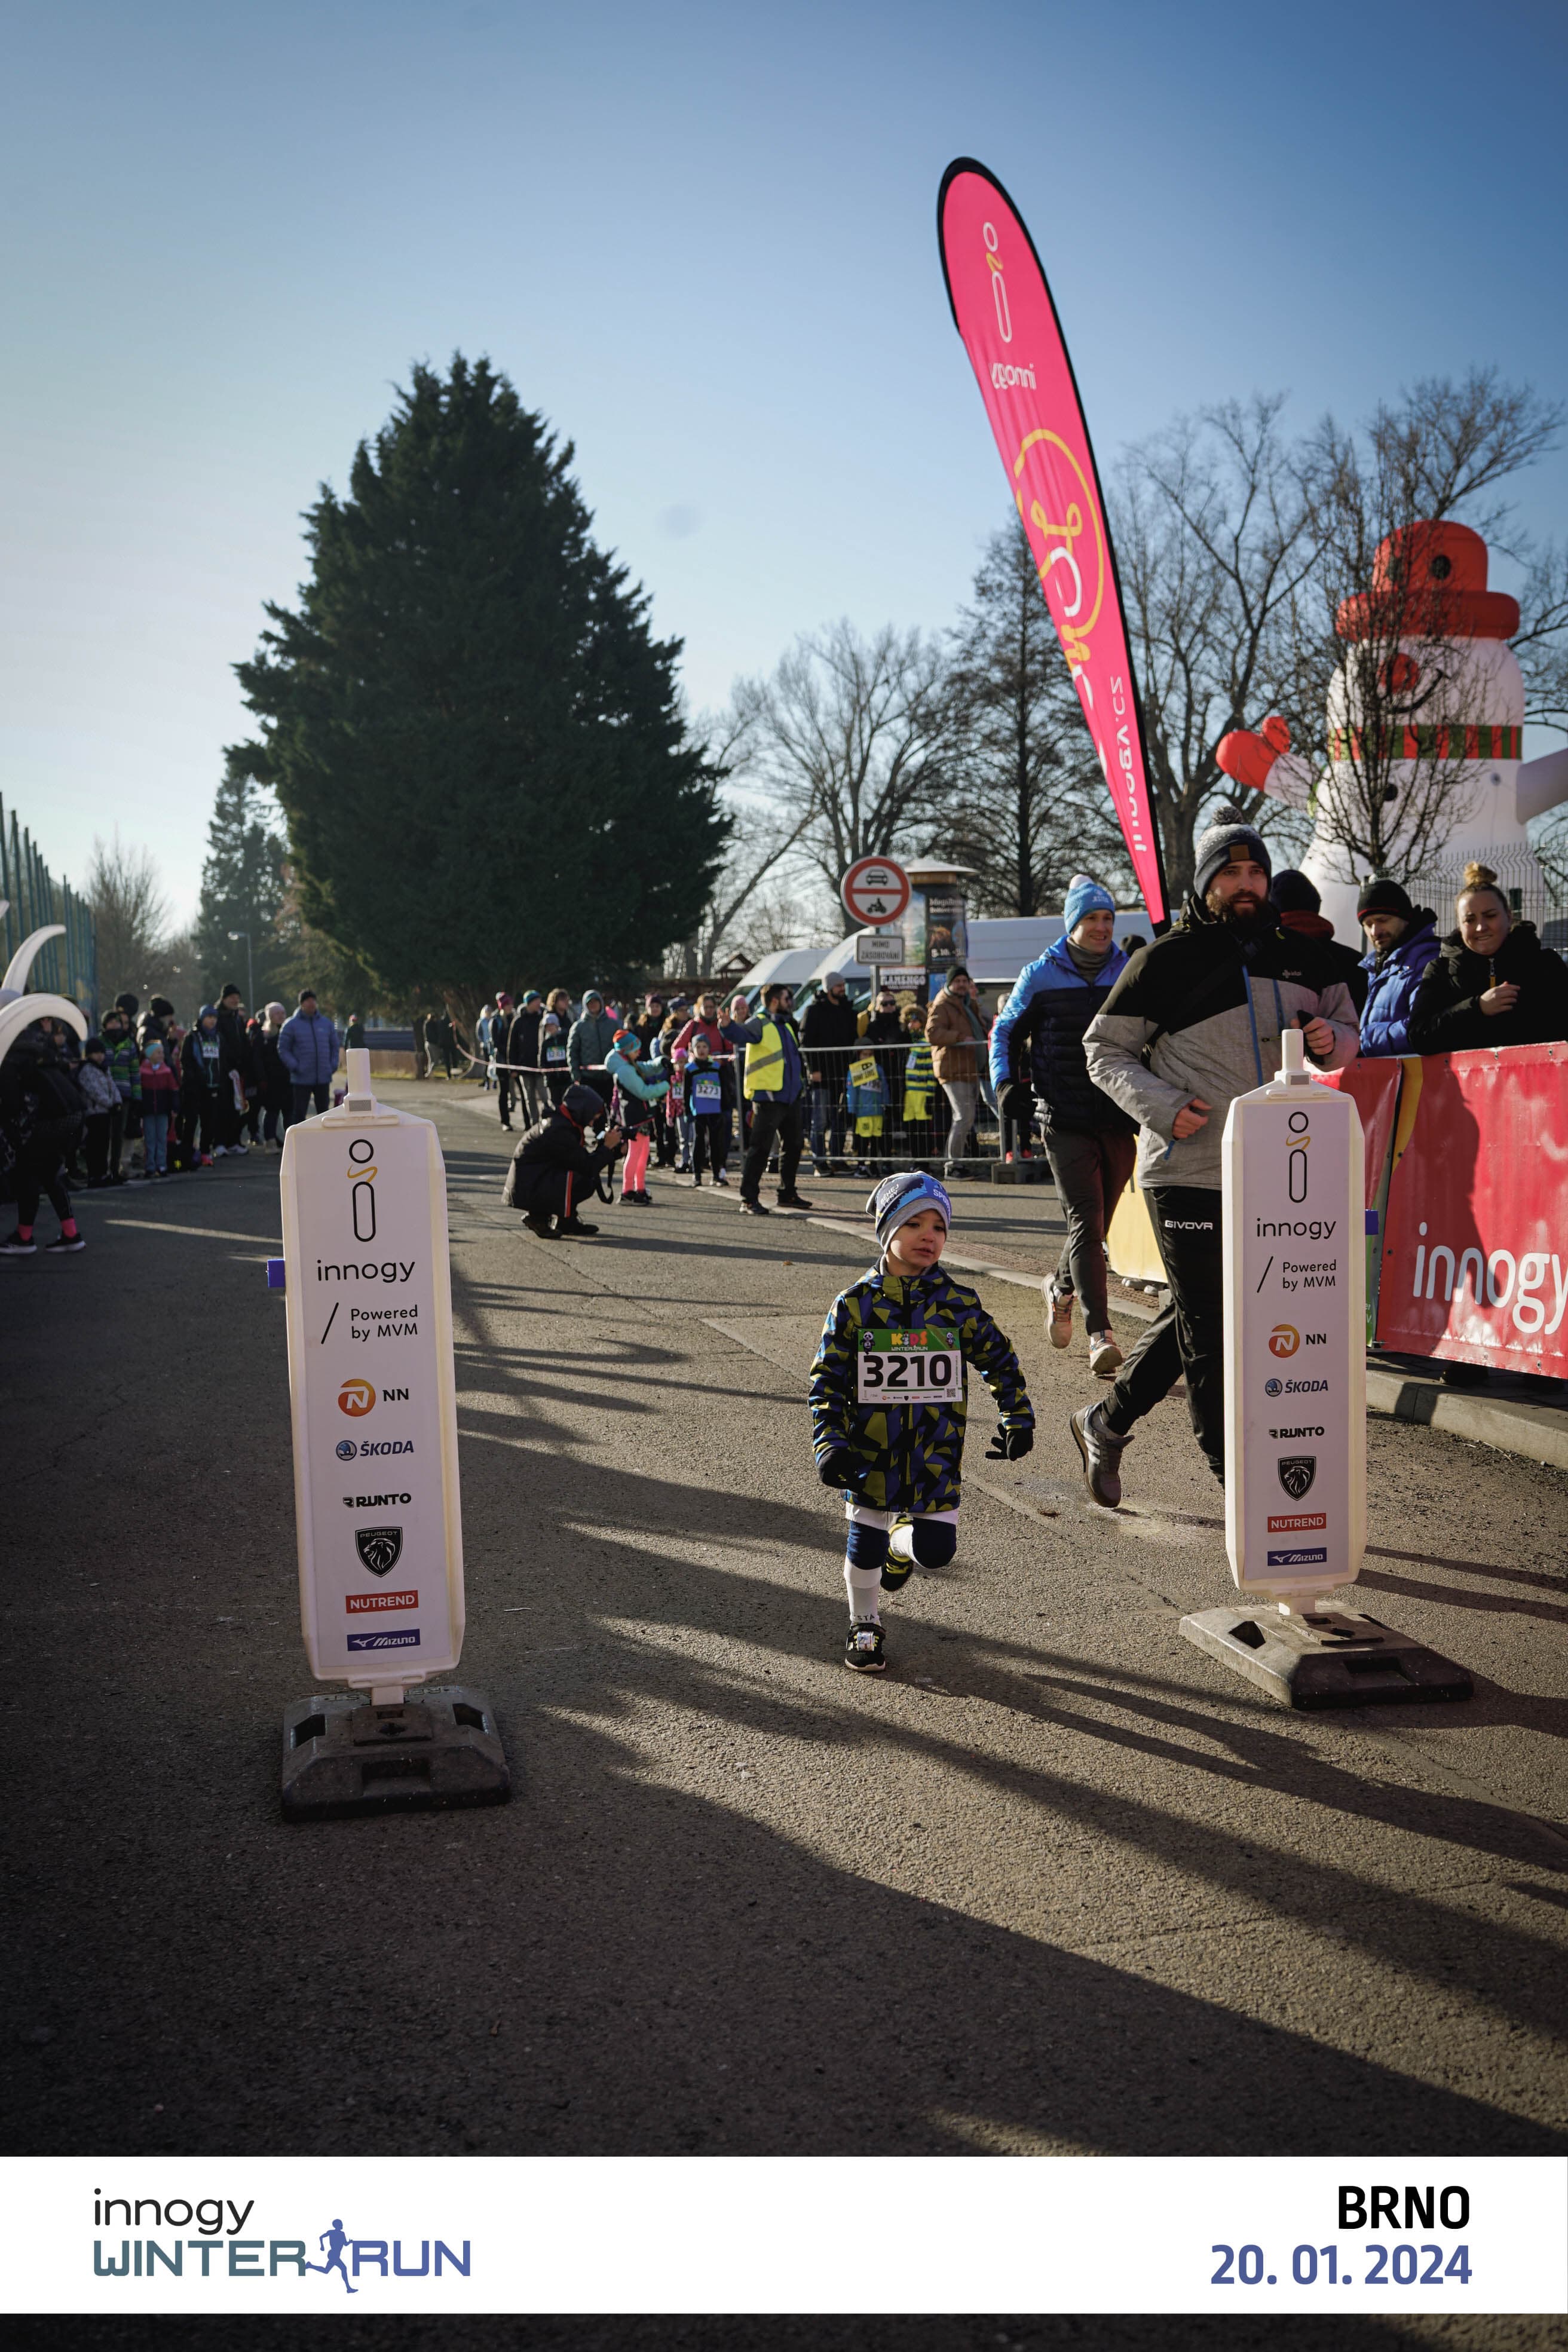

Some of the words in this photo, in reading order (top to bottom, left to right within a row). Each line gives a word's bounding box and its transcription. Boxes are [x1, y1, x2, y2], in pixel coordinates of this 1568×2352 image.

[1165, 1220, 1213, 1230] GIVOVA
[1257, 1218, 1336, 1240] innogy
[317, 1260, 415, 1283] innogy
[1283, 1259, 1337, 1273] Powered
[1283, 1278, 1298, 1291] by
[1303, 1276, 1336, 1288] MVM
[1413, 1221, 1568, 1335] innogy
[351, 1304, 418, 1321] Powered
[351, 1326, 370, 1342] by
[377, 1323, 418, 1337] MVM
[1306, 1334, 1327, 1345] NN
[863, 1354, 951, 1388] 3210
[1285, 1379, 1328, 1393] ŠKODA
[382, 1388, 409, 1401] NN
[1280, 1426, 1325, 1438] RUNTO
[360, 1440, 414, 1456] ŠKODA
[356, 1493, 412, 1507] RUNTO
[1271, 1517, 1324, 1529] NUTREND
[350, 1595, 415, 1609] NUTREND
